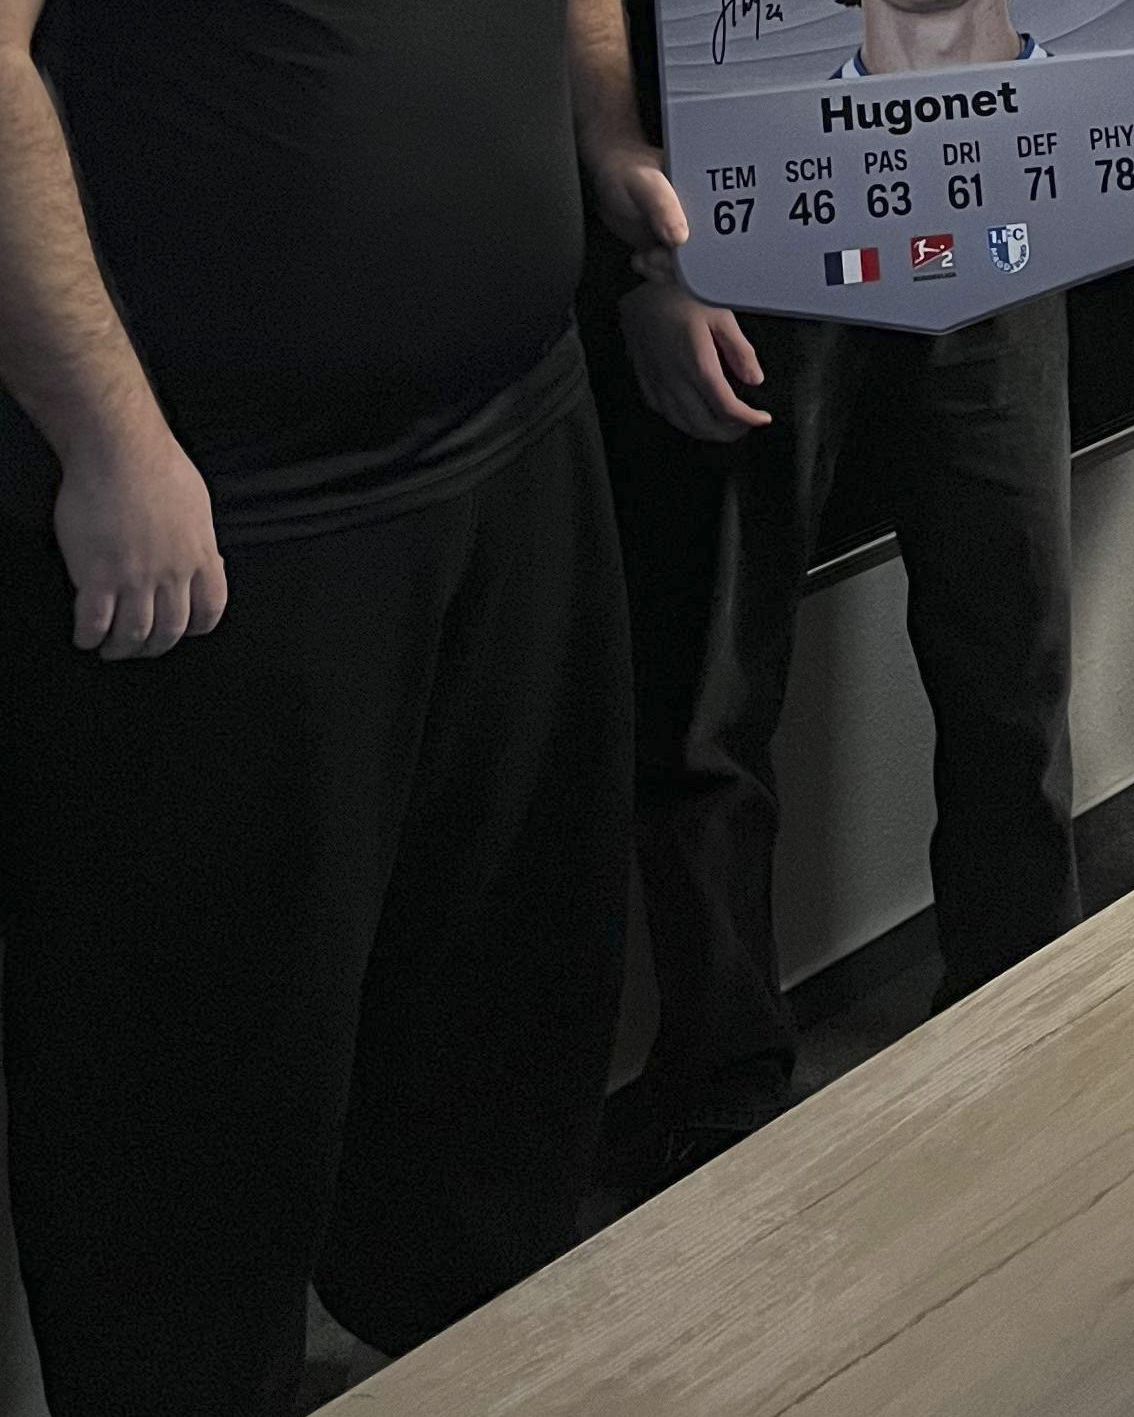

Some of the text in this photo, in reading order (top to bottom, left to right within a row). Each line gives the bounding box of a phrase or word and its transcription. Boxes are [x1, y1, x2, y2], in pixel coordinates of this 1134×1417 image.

[821, 82, 1019, 136] Hugonet
[706, 124, 1134, 192] TEM SCH PAS DRI DEF PHY
[713, 198, 755, 235] 67
[789, 189, 836, 226] 46
[867, 181, 912, 218] 63
[948, 173, 983, 209] 61
[1024, 165, 1057, 201] 71
[941, 251, 954, 268] 2
